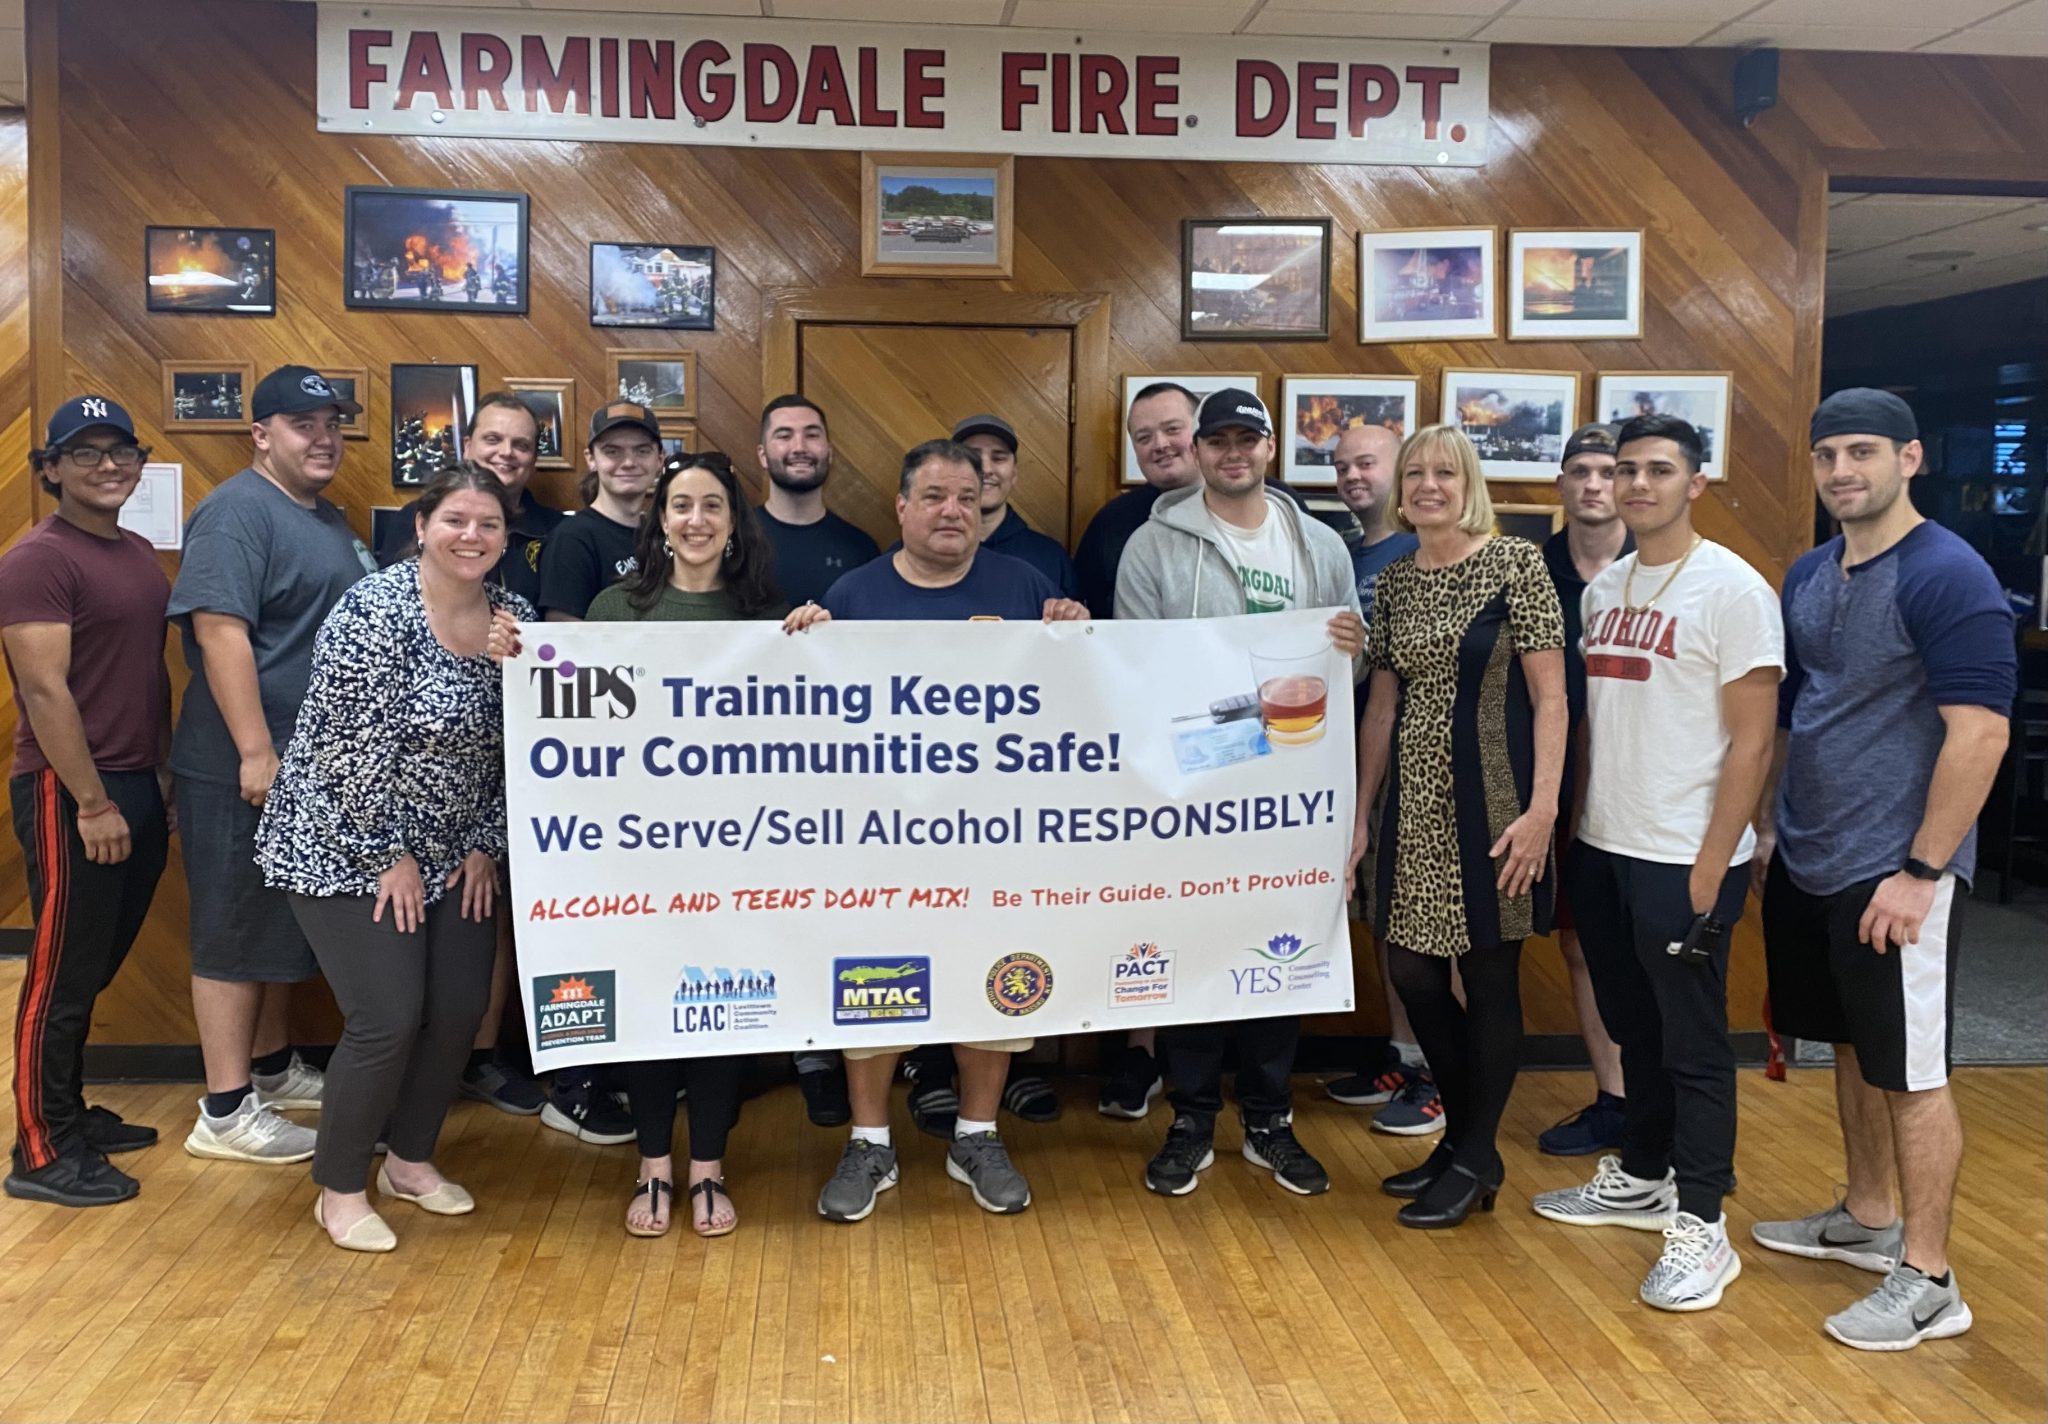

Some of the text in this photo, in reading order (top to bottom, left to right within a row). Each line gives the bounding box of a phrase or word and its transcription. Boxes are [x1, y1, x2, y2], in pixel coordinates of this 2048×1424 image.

[348, 28, 1467, 143] FARMINGDALE FIRE DEPT.
[663, 675, 872, 724] Training
[891, 675, 1041, 724] Keeps
[530, 732, 1120, 778] Our Communities Safe!
[531, 790, 1335, 852] We Serve/Sell Alcohol RESPONSIBLY!
[530, 893, 658, 921] ALCOHOL
[668, 891, 721, 914] AND
[732, 887, 816, 912] TEENS
[908, 887, 969, 909] MIX!
[992, 889, 1022, 908] Be
[1031, 887, 1091, 907] Their
[1099, 883, 1172, 904] Guide.
[1180, 876, 1241, 899] Don't
[1247, 867, 1336, 893] Provide.
[1116, 960, 1169, 978] PACT
[1228, 966, 1282, 994] YES
[843, 986, 921, 1007] MTAC
[1114, 986, 1149, 994] Change
[540, 999, 605, 1013] FARMINGDALE
[541, 1008, 606, 1029] ADAPT
[674, 1004, 725, 1033] LCAC
